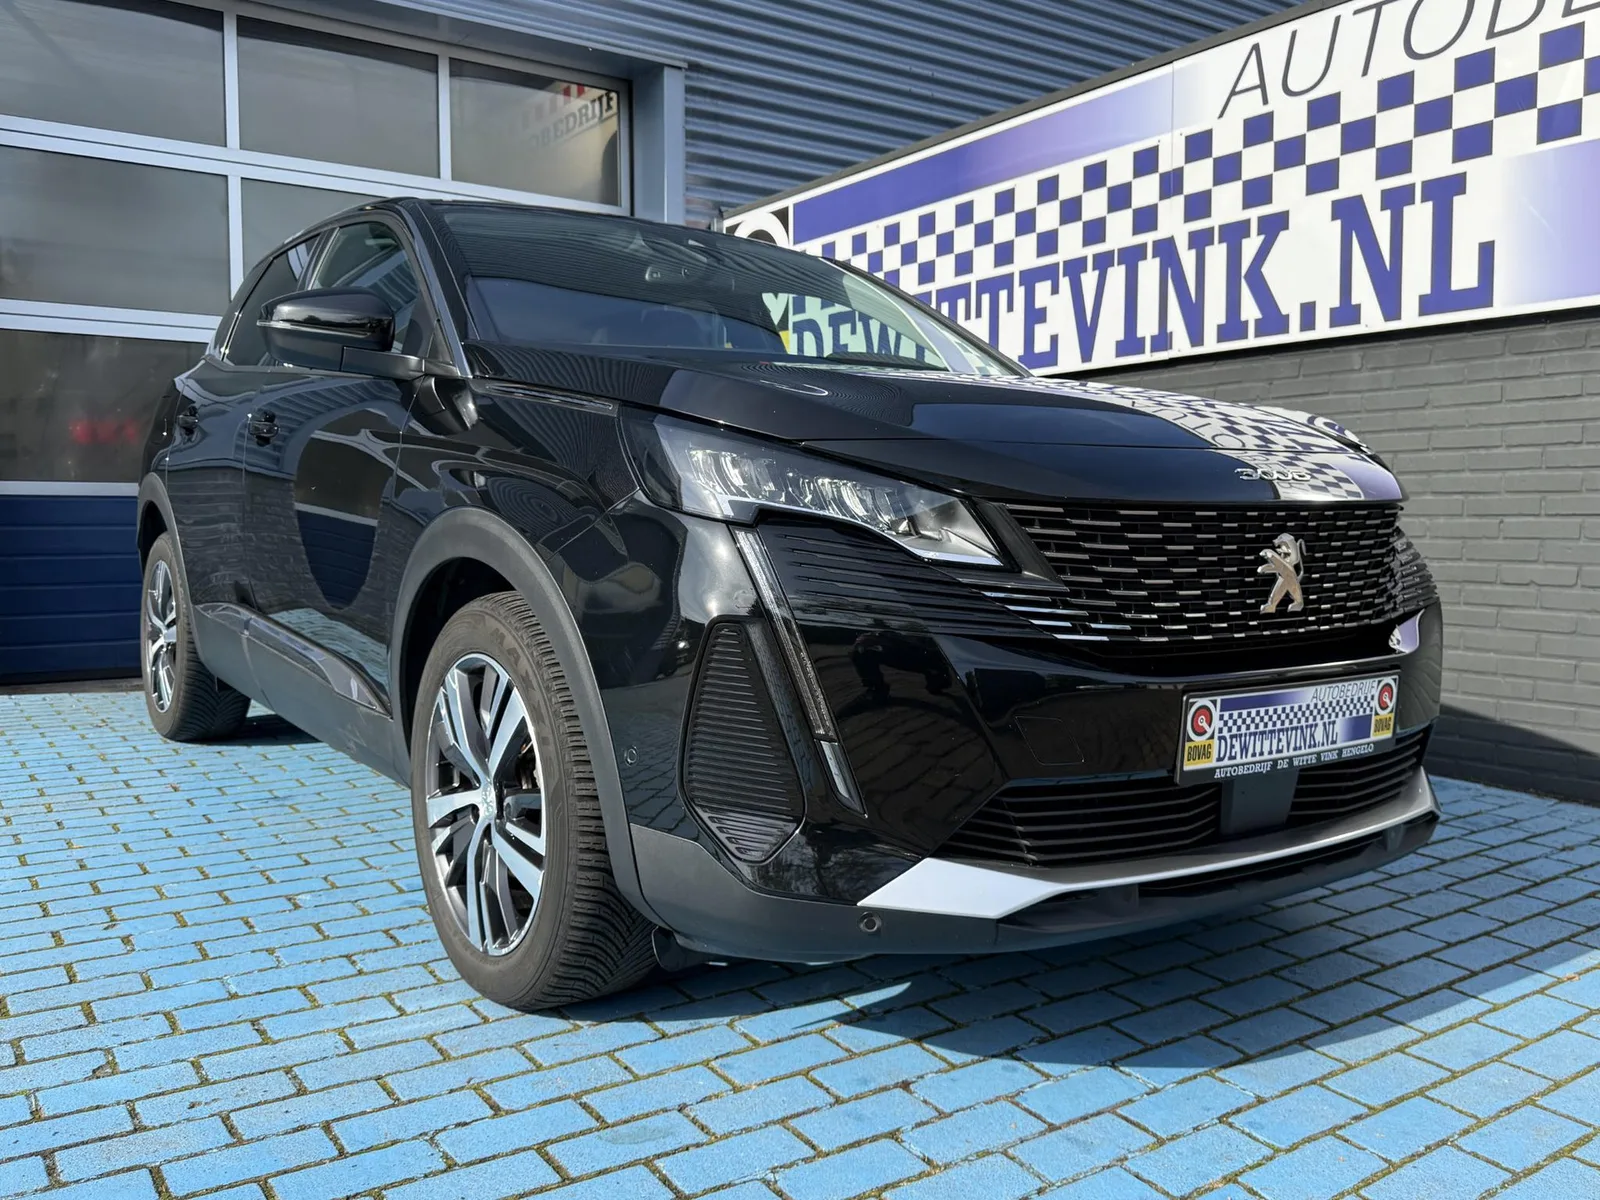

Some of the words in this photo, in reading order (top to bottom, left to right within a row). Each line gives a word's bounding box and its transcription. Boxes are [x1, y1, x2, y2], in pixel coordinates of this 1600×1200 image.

[1217, 0, 1600, 119] AUTO
[1310, 680, 1376, 702] AUTOBEDRIJF
[1187, 743, 1212, 762] BOVAG
[1216, 720, 1338, 763] DEWITTEVINK.NL
[1214, 761, 1273, 779] AUTOBEDRIJF
[1277, 759, 1290, 769] DE
[1293, 755, 1318, 767] WITTE
[1321, 750, 1338, 761] VINK
[1342, 743, 1374, 758] HENGELO
